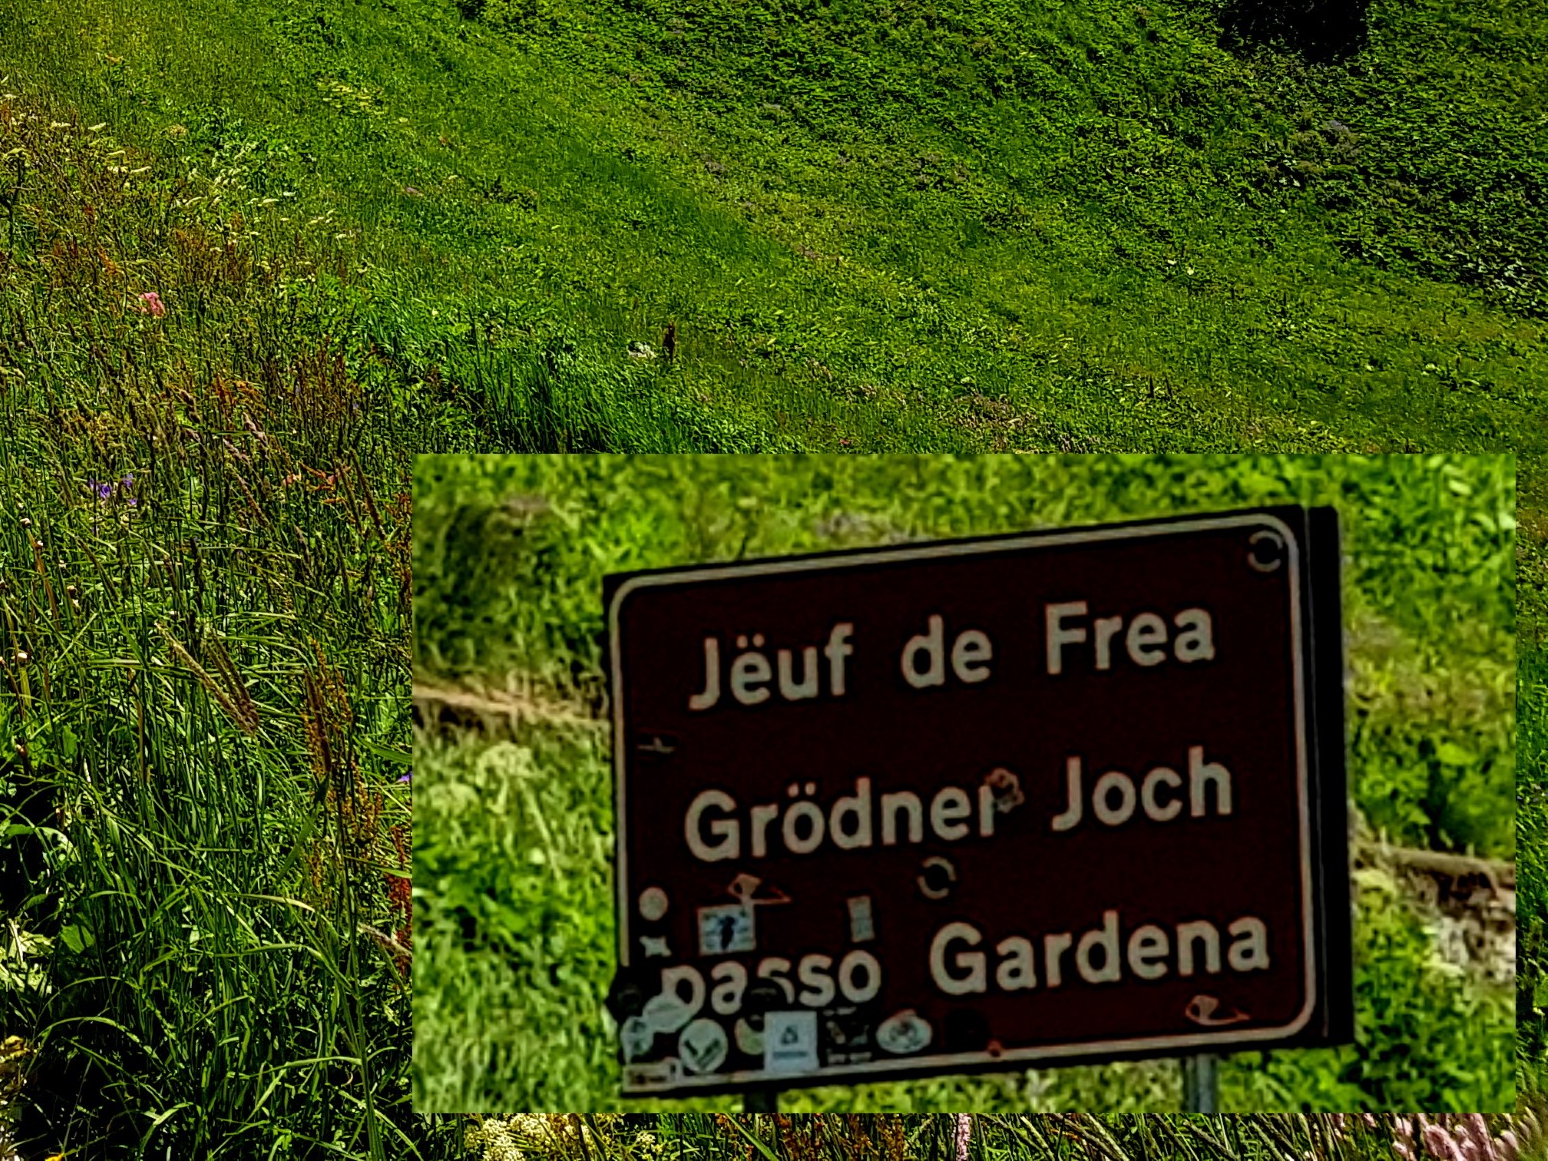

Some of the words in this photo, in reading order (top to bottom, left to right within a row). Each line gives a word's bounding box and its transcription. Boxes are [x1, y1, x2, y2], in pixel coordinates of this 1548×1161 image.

[688, 621, 854, 712] Jëuf
[900, 614, 993, 691] de
[1044, 601, 1216, 676] Frea
[1050, 744, 1234, 833] Joch
[928, 909, 1271, 997] Gardena
